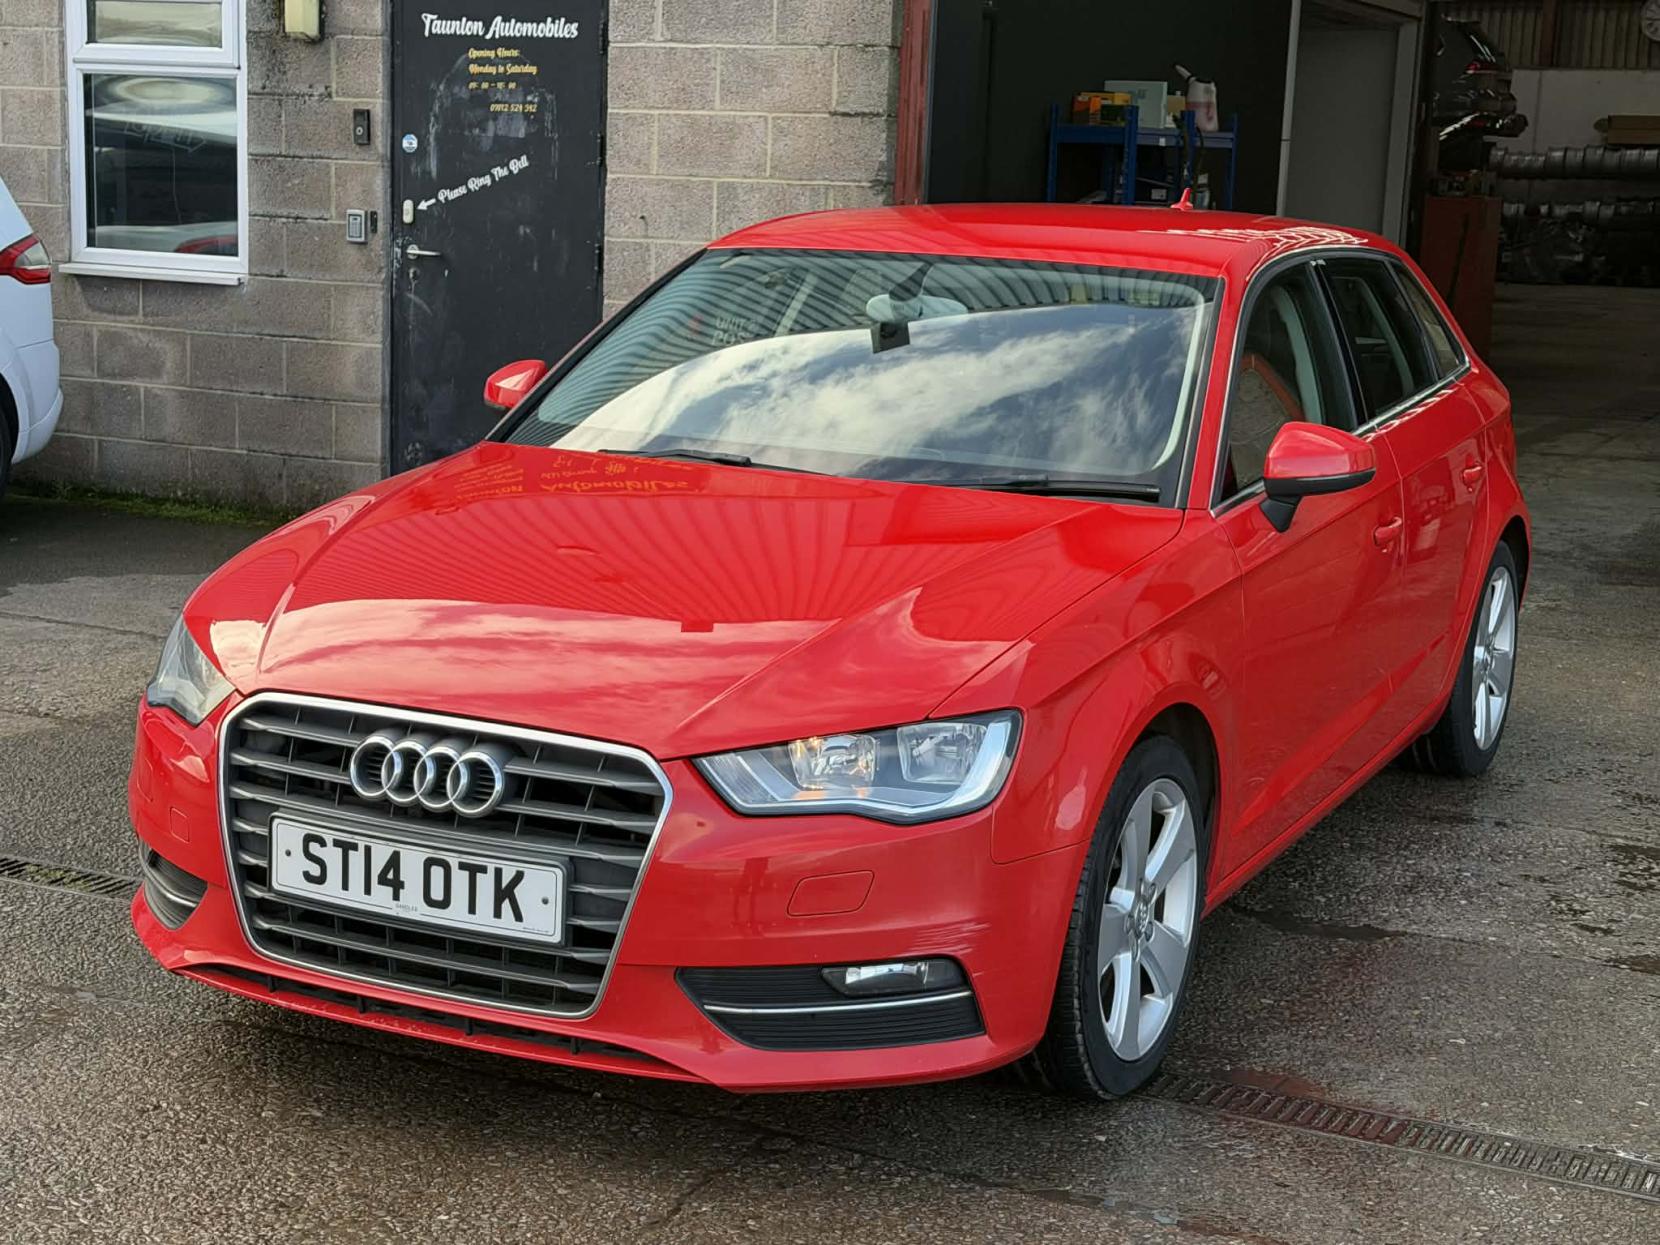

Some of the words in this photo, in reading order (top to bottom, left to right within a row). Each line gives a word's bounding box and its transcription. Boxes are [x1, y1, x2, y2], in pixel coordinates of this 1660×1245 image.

[421, 13, 485, 37] Taunton
[485, 15, 578, 39] Automobiles
[468, 47, 495, 59] Opening
[468, 63, 497, 75] Monday
[506, 63, 537, 75] Saturday
[438, 184, 468, 204] Please
[467, 174, 491, 192] Ring
[491, 166, 509, 181] The
[509, 154, 529, 174] Bell
[302, 832, 405, 901] ST14
[423, 856, 525, 922] OTK
